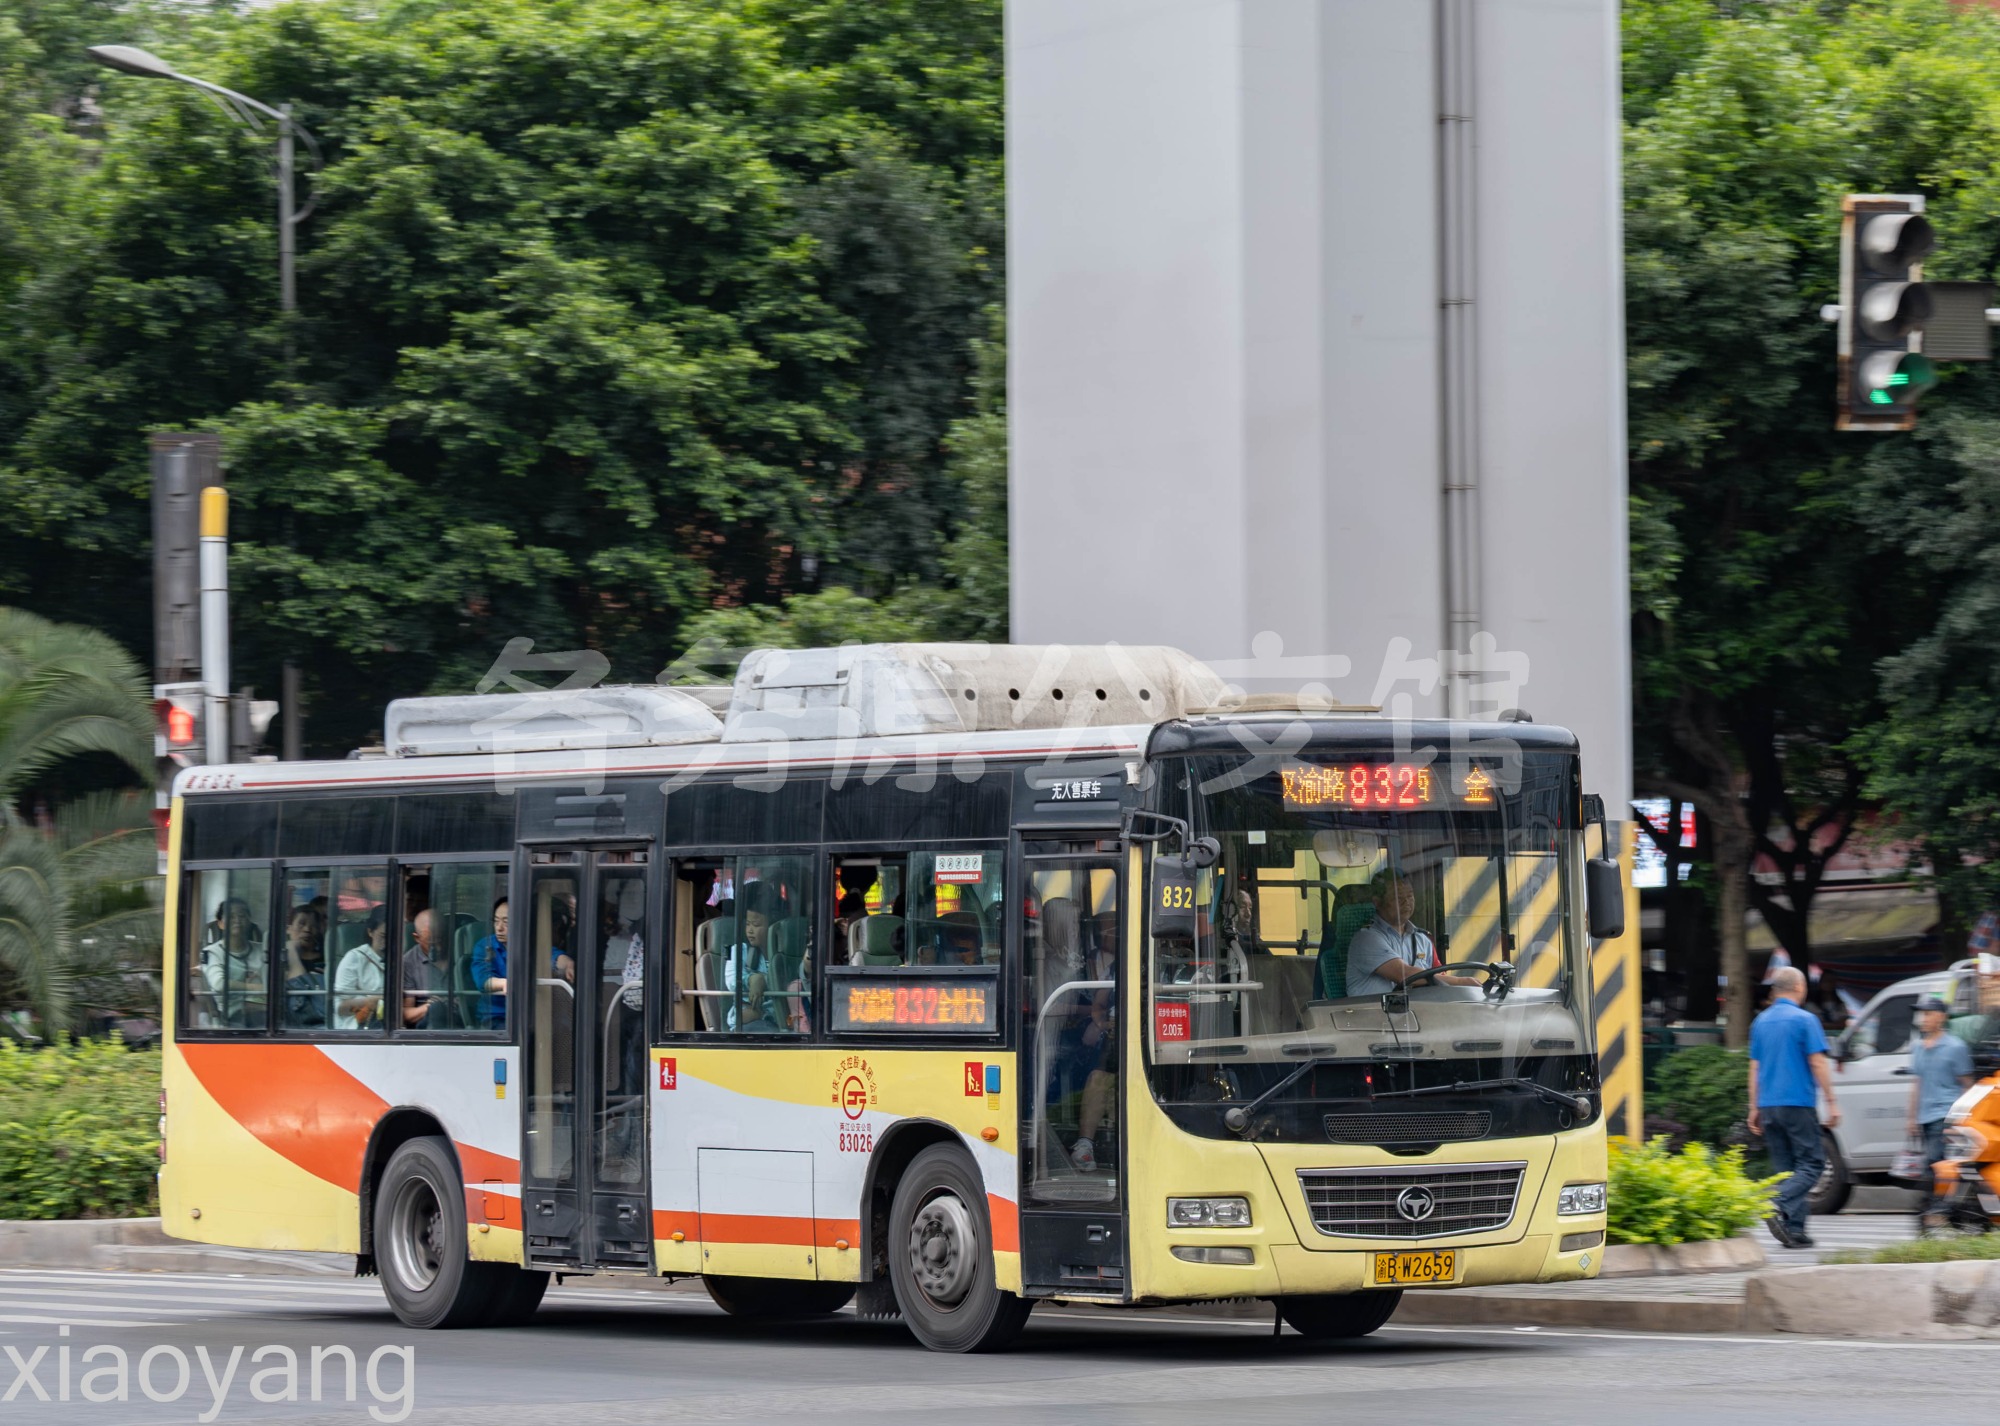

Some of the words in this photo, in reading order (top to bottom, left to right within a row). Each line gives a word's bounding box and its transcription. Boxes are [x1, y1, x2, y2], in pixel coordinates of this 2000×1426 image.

[1051, 781, 1102, 799] 无人售票车
[1162, 885, 1193, 909] 832
[1162, 1023, 1184, 1036] 2.00元
[839, 1132, 873, 1153] 83026
